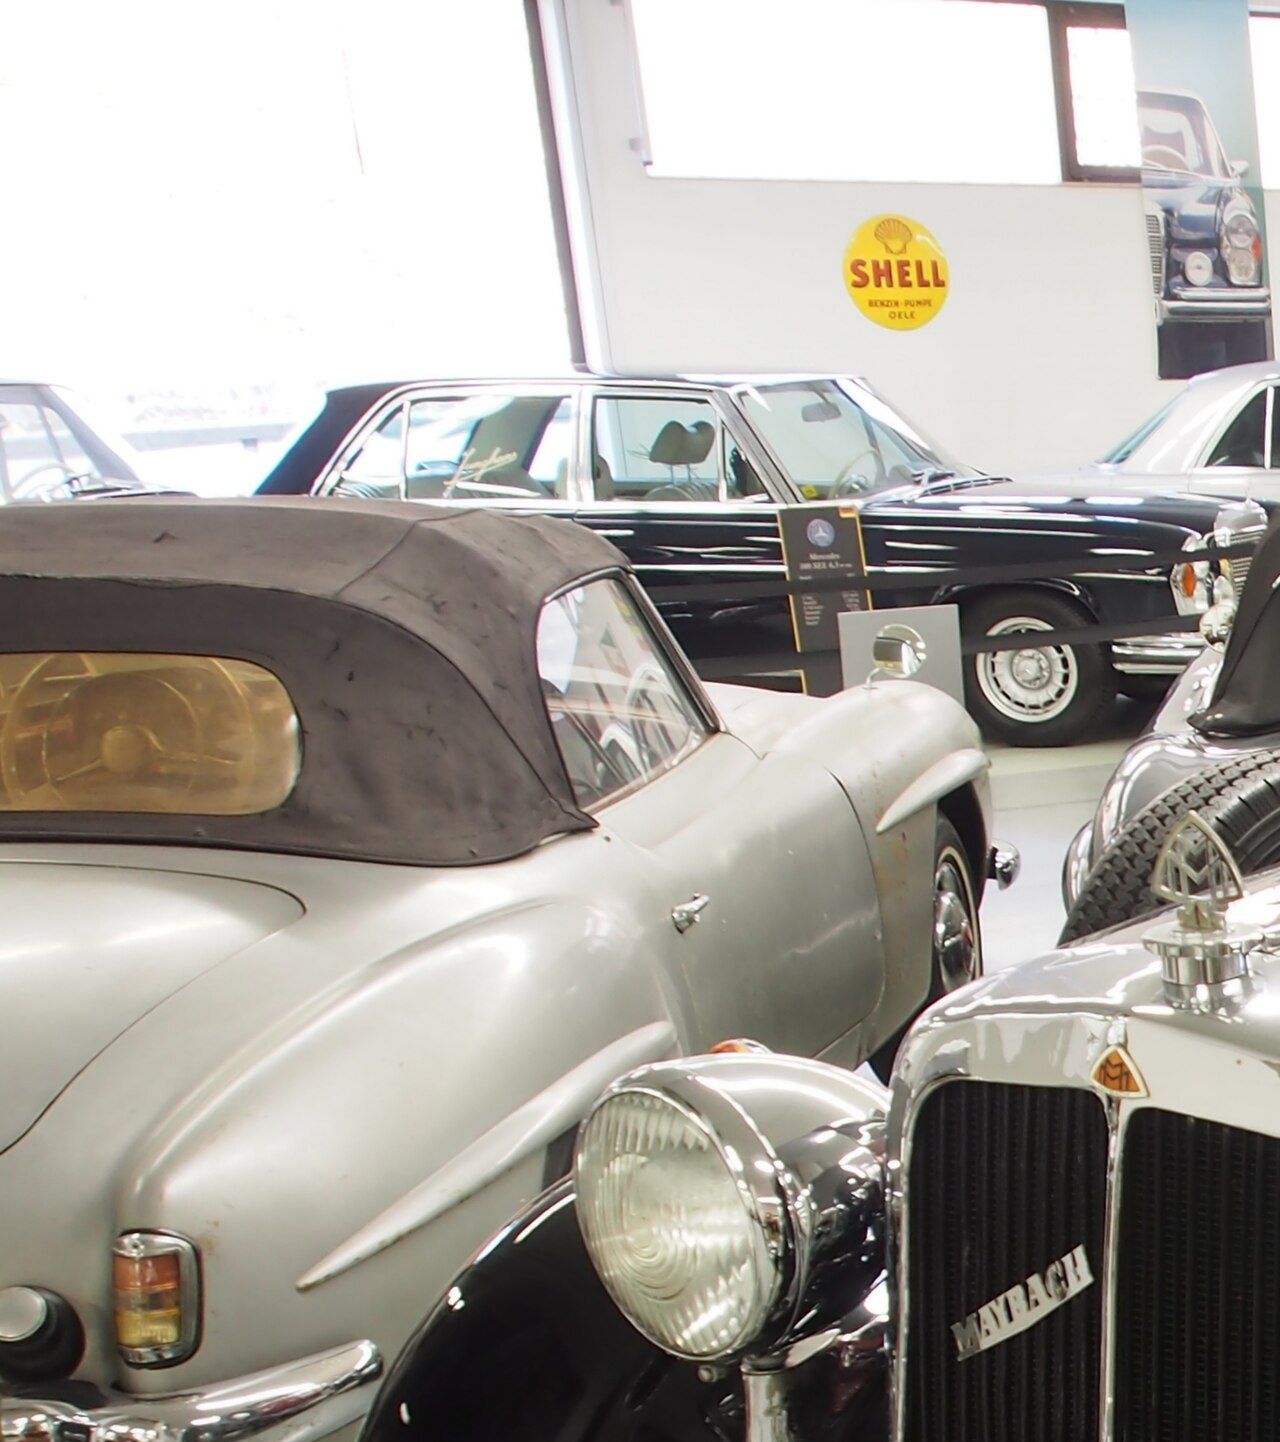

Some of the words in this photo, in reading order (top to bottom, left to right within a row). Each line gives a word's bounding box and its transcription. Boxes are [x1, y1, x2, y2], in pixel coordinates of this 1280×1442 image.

[850, 259, 946, 288] SHELL
[889, 311, 915, 319] OELE
[950, 1244, 1095, 1362] MAYBACH
